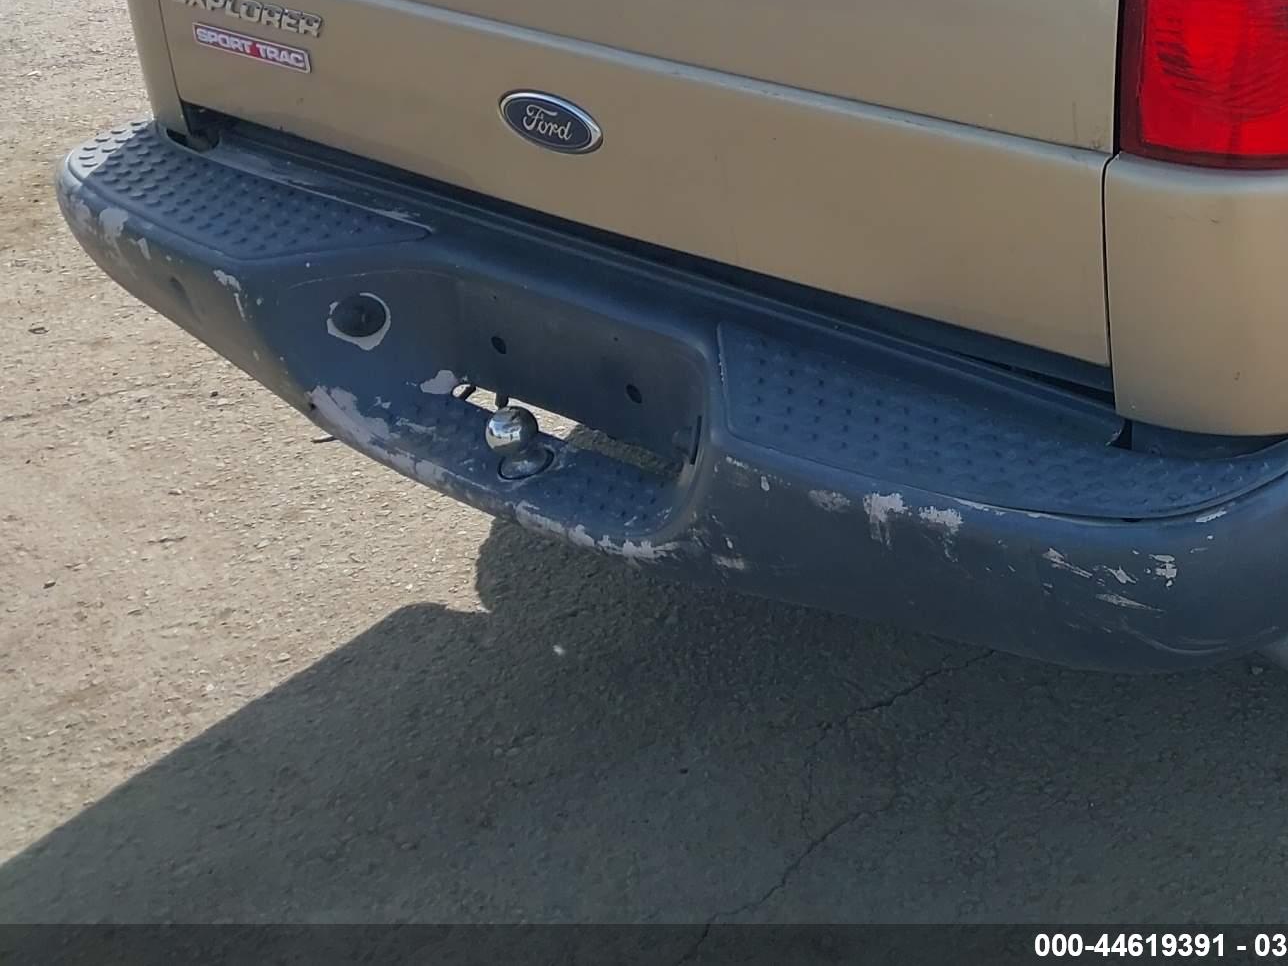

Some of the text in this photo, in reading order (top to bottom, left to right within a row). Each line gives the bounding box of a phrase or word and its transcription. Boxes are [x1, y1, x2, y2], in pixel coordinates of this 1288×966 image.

[196, 28, 305, 68] SPORT TRAC
[522, 104, 573, 141] Ford
